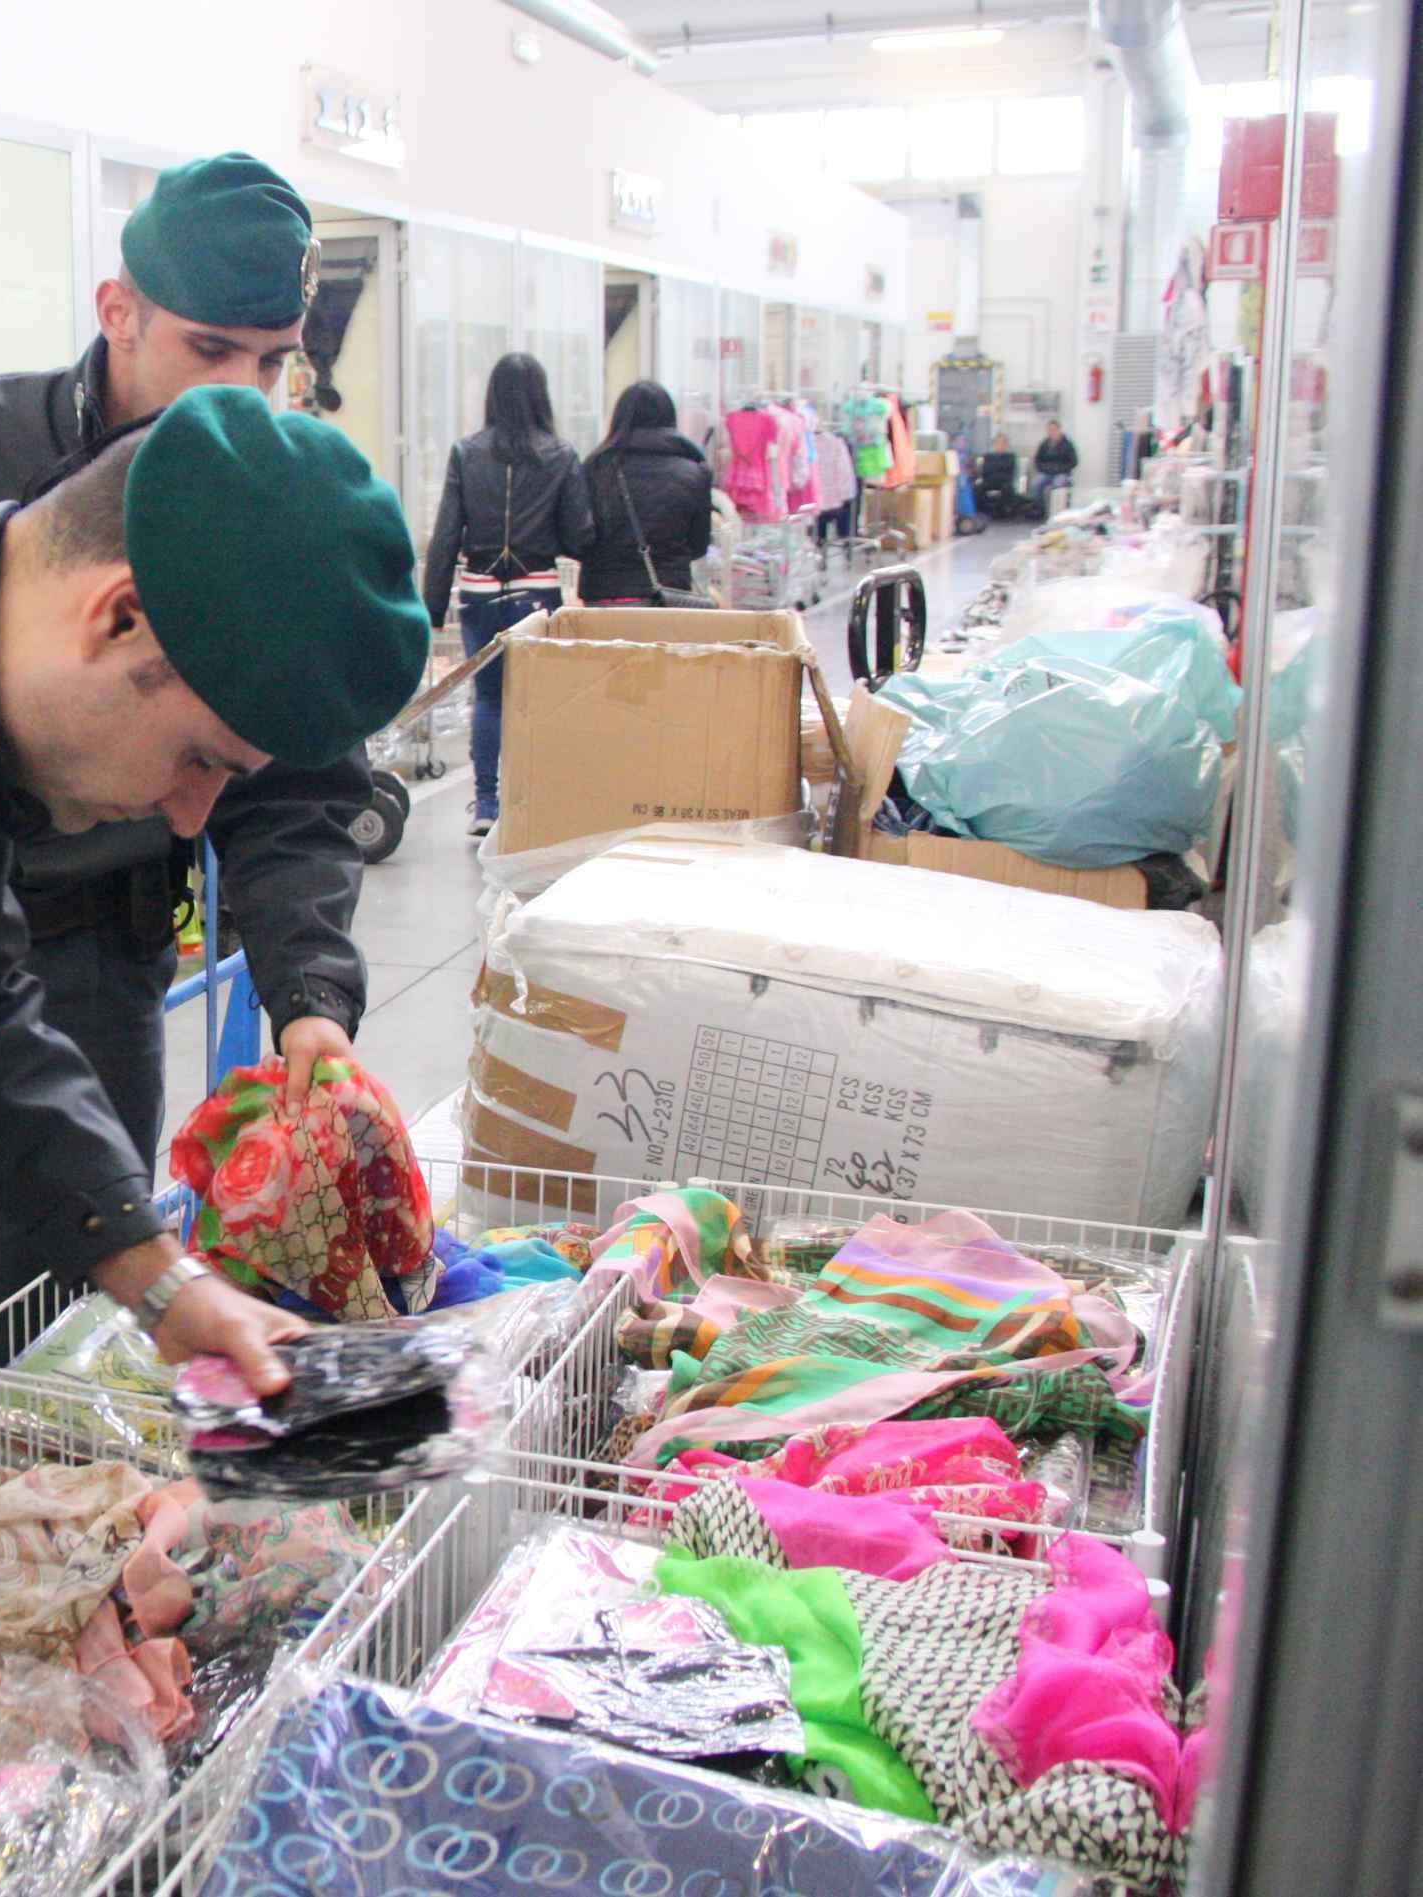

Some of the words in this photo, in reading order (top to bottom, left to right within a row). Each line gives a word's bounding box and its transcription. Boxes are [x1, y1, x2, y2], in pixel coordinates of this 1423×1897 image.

[701, 1031, 716, 1046] 52
[697, 1052, 712, 1067] 50
[861, 1083, 884, 1117] KGS
[884, 1088, 908, 1123] KGS
[910, 1090, 932, 1118] CM
[824, 1158, 846, 1179] 72
[837, 1077, 860, 1112] PCS
[903, 1125, 926, 1147] 73
[901, 1151, 920, 1162] X
[897, 1166, 918, 1189] 37
